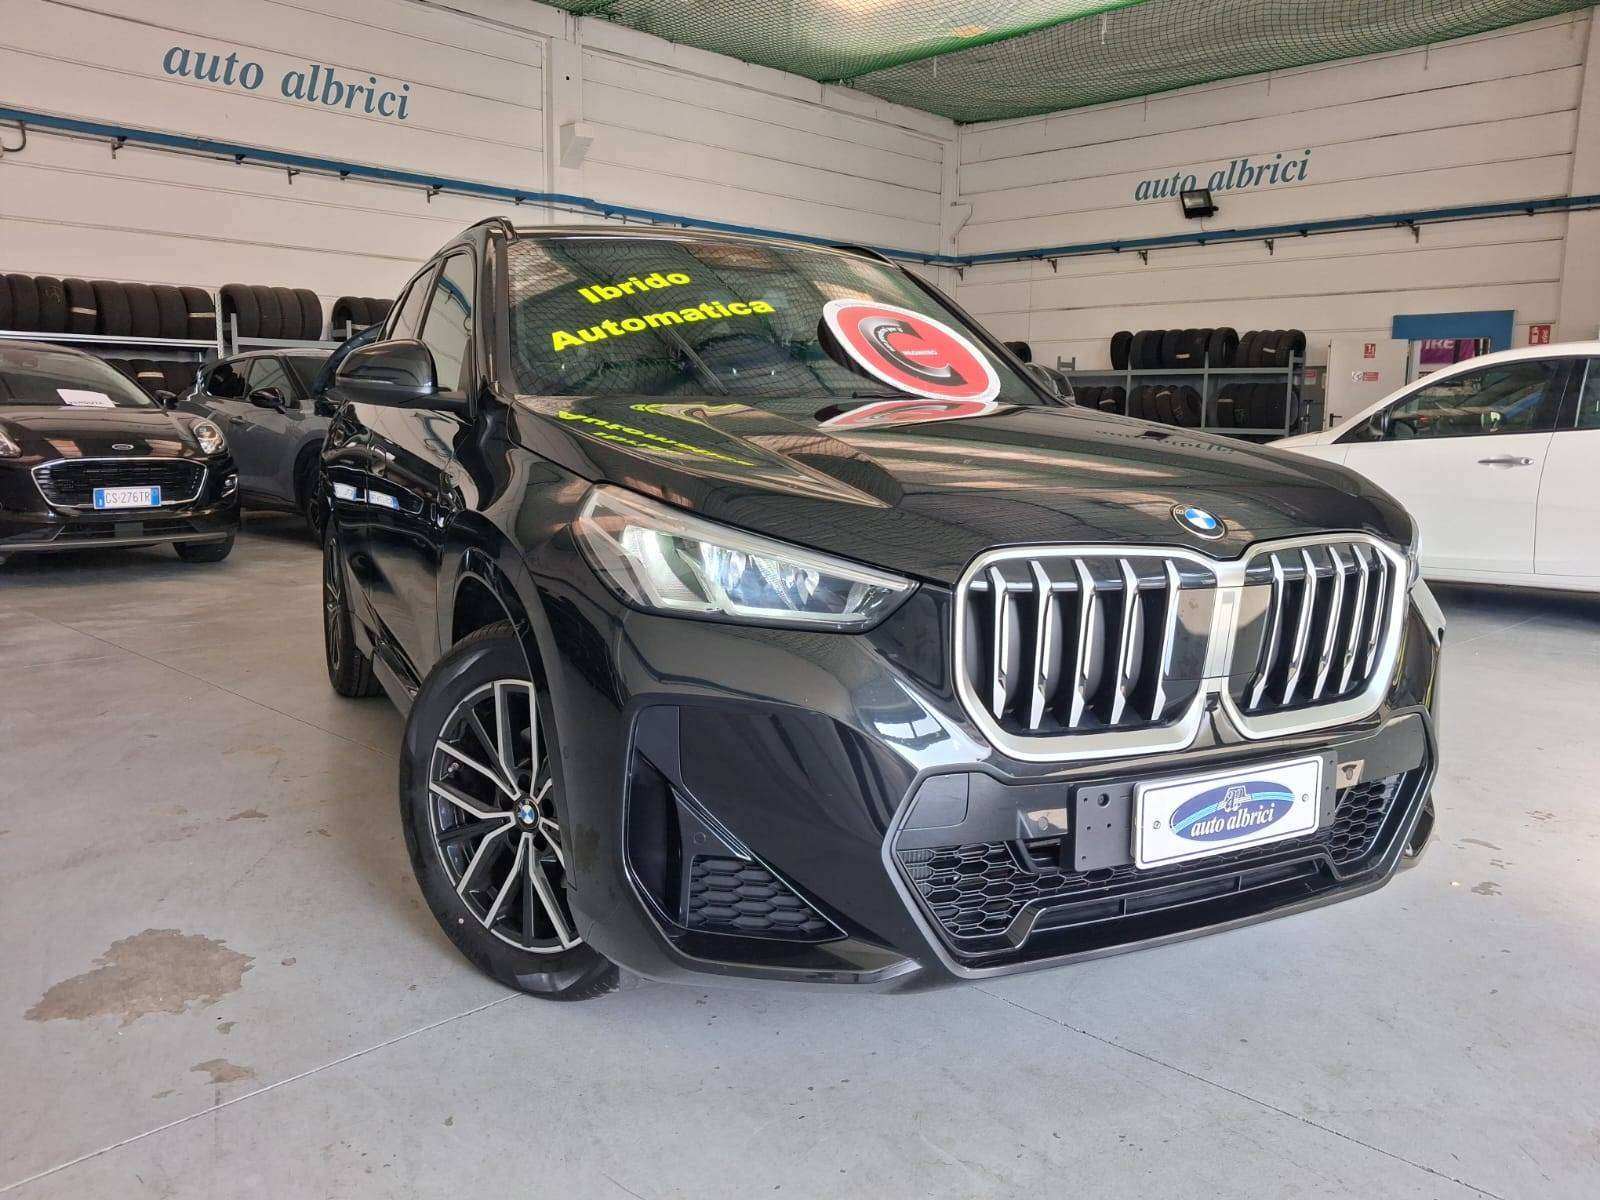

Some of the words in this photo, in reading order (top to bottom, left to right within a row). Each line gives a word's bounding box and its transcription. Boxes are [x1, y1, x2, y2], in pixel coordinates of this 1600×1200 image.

[162, 46, 264, 90] auto
[281, 64, 410, 120] albrici
[1134, 171, 1198, 202] auto
[1207, 149, 1312, 192] albrici
[577, 272, 692, 304] Ibrido
[550, 300, 776, 353] Automatica
[1190, 817, 1224, 838] auto
[1227, 802, 1276, 832] albrici
